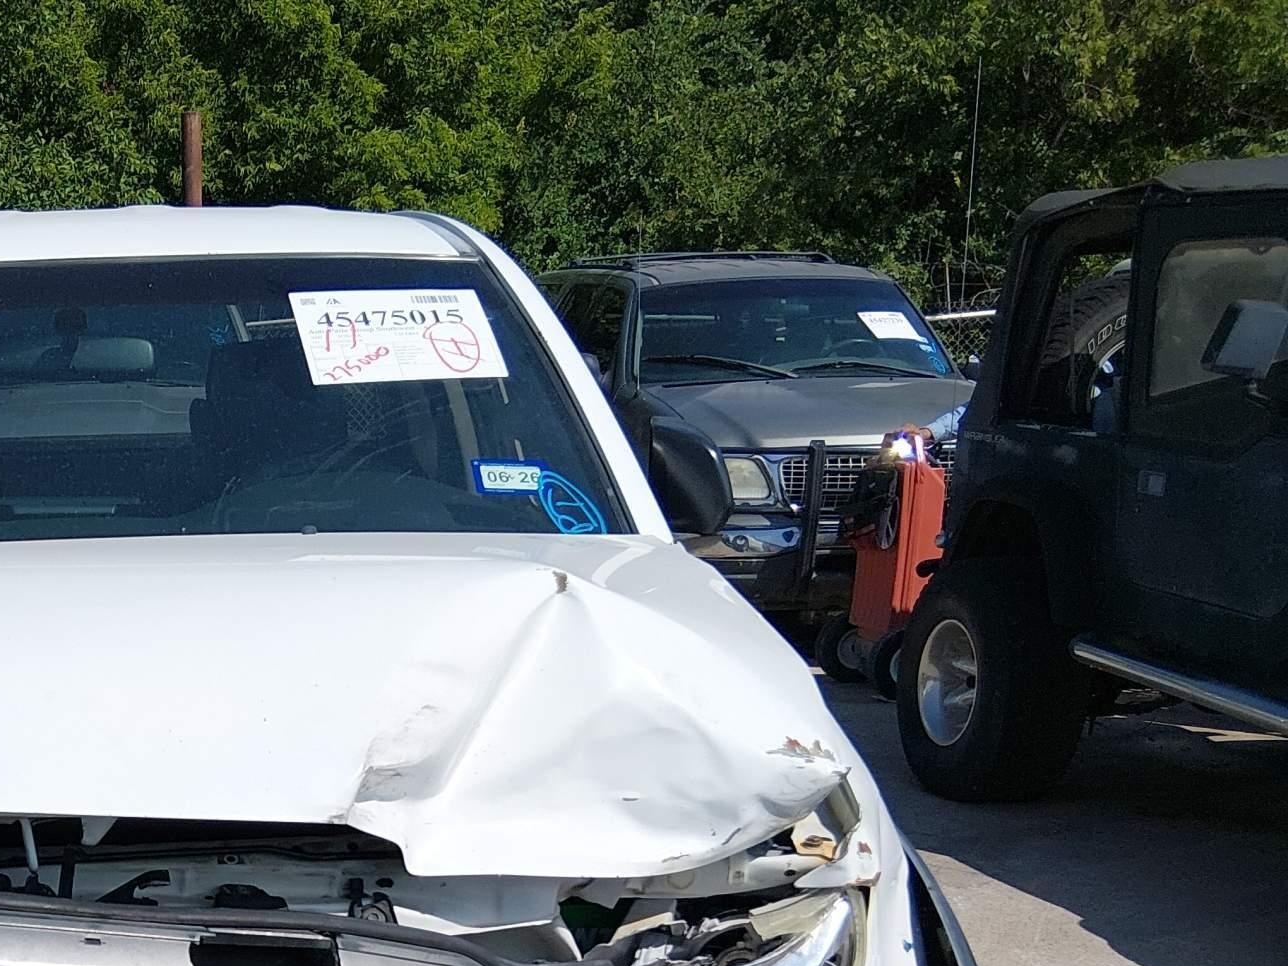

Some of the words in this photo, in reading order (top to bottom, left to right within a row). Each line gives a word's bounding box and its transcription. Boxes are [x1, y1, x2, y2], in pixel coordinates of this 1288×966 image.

[317, 309, 463, 328] 45475015
[487, 471, 509, 483] 06
[518, 471, 539, 483] 26
